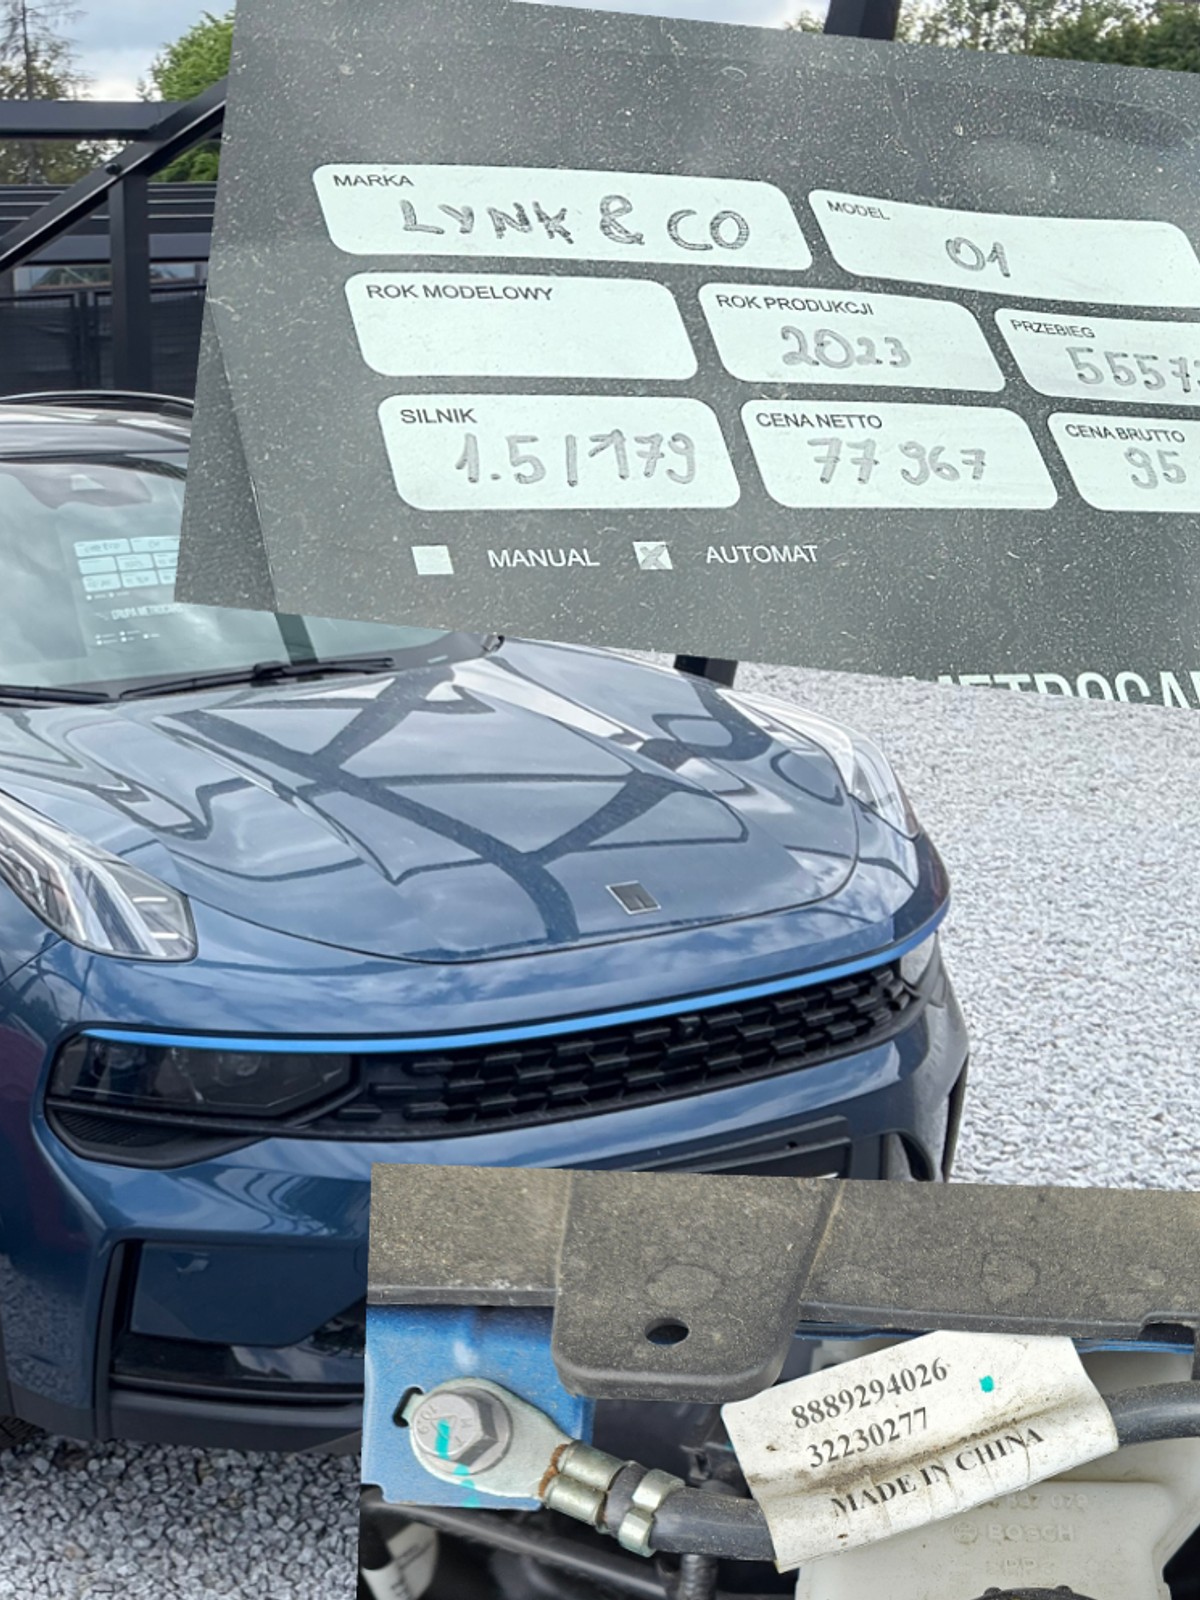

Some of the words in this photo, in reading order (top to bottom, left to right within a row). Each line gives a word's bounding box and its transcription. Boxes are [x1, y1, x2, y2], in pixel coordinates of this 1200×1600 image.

[332, 173, 414, 188] MARKA
[826, 200, 891, 221] MODEL
[400, 199, 574, 245] LYNK
[599, 194, 645, 247] &
[666, 208, 750, 251] CO
[366, 283, 419, 300] ROK
[422, 284, 554, 301] MODELOWY
[715, 293, 762, 311] ROK
[764, 296, 874, 316] PRODUKCJI
[1011, 318, 1096, 338] PRZEBIEG
[780, 325, 912, 369] 2023
[1065, 345, 1200, 394] 5557
[400, 408, 478, 424] SILNIK
[756, 413, 812, 429] CENA
[817, 413, 883, 430] NETTO
[1065, 424, 1116, 440] CENA
[1115, 427, 1186, 443] BRUTTO
[488, 548, 601, 568] MANUAL
[706, 544, 819, 565] AUTOMAT
[791, 1356, 948, 1429] 8889294026
[806, 1406, 927, 1468] 32230277
[831, 1474, 917, 1517] MADE
[919, 1462, 951, 1486] IN
[955, 1427, 1045, 1471] CHINA
